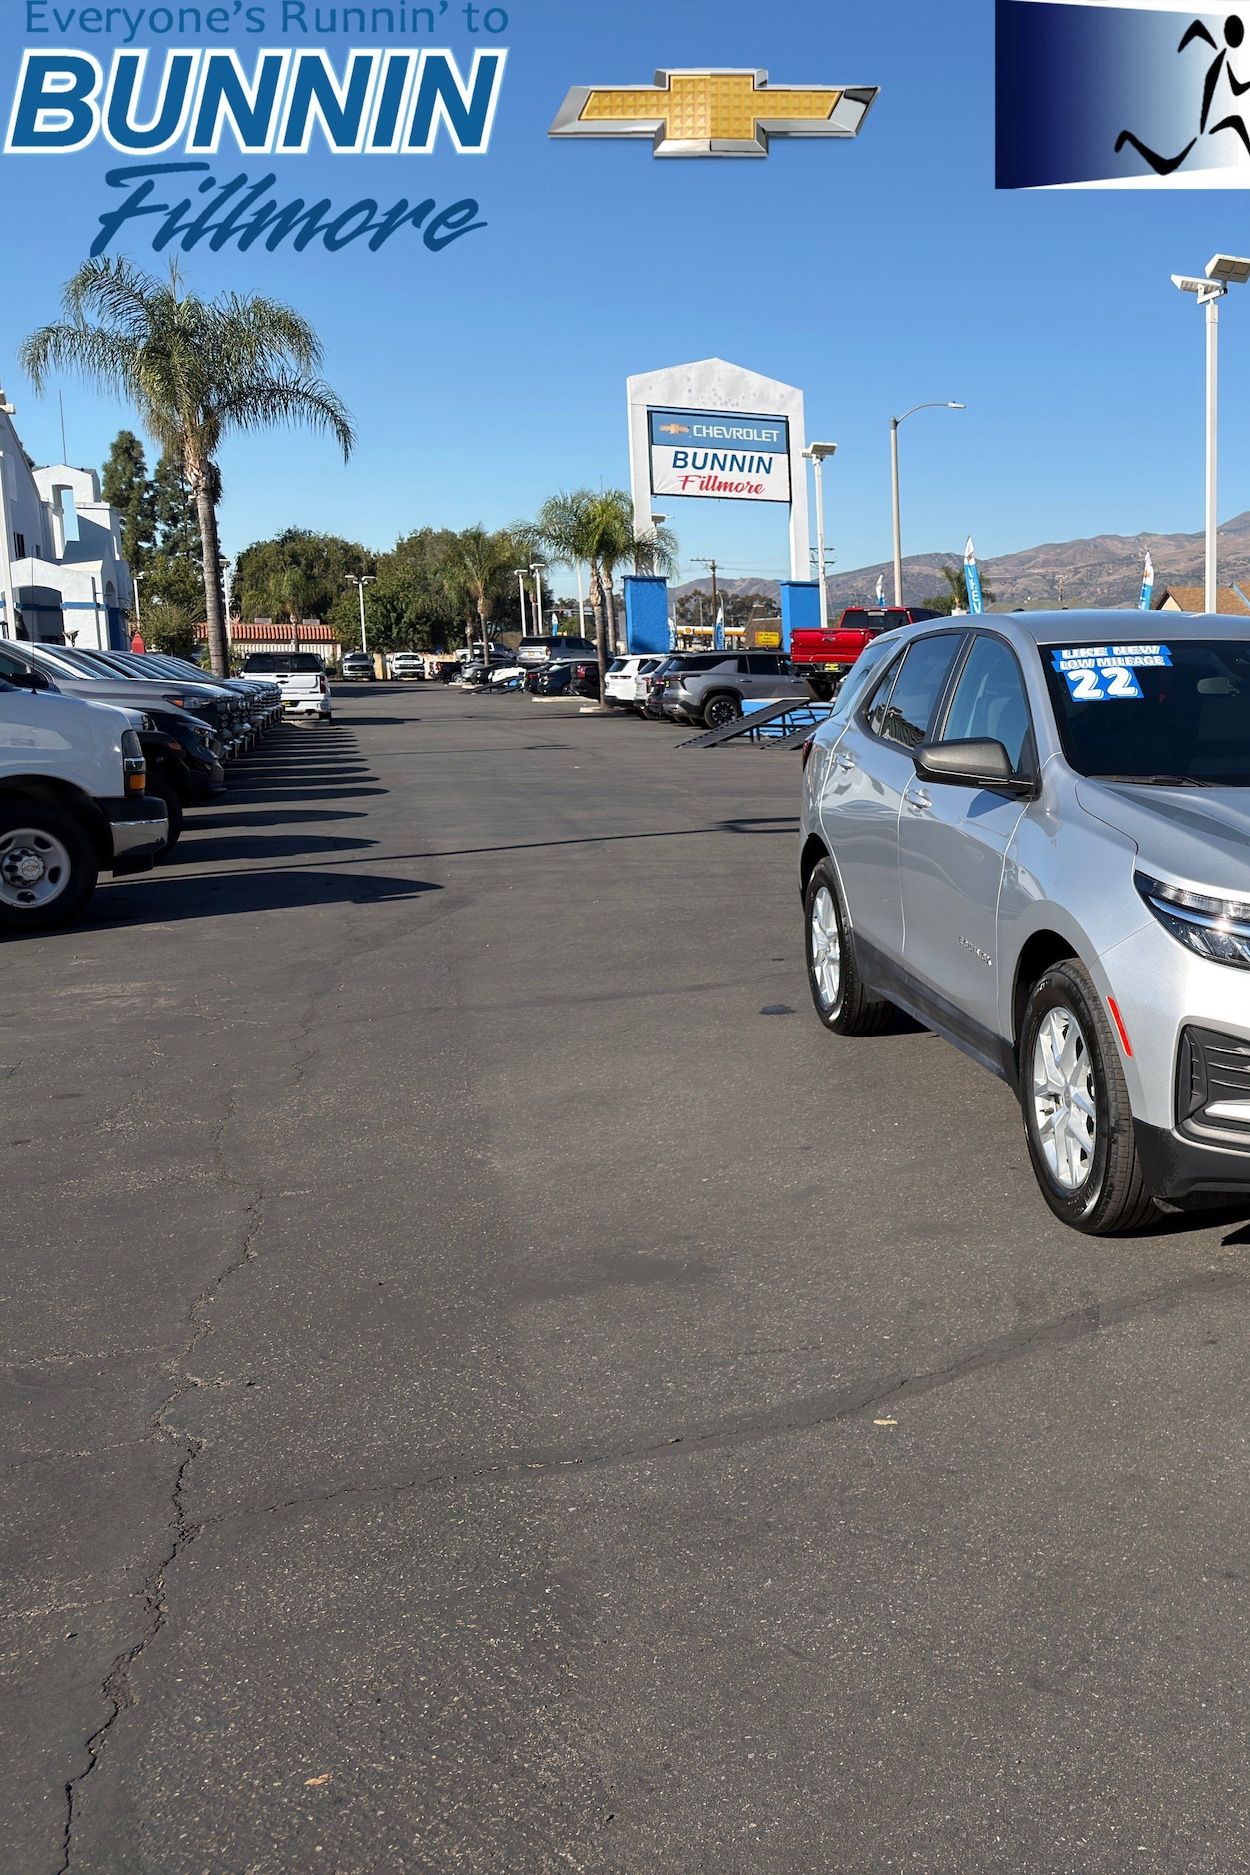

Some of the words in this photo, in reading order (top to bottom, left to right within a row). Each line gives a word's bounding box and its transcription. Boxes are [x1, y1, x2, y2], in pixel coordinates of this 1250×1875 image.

[693, 424, 779, 442] CHEVROLET
[672, 450, 773, 475] BUNNIN
[677, 474, 766, 494] Fillmore
[1061, 647, 1108, 659] LIKE
[1112, 645, 1161, 656] NEW
[1060, 659, 1095, 671] LOW
[1096, 656, 1166, 668] MILEAGE
[1067, 667, 1139, 700] 22
